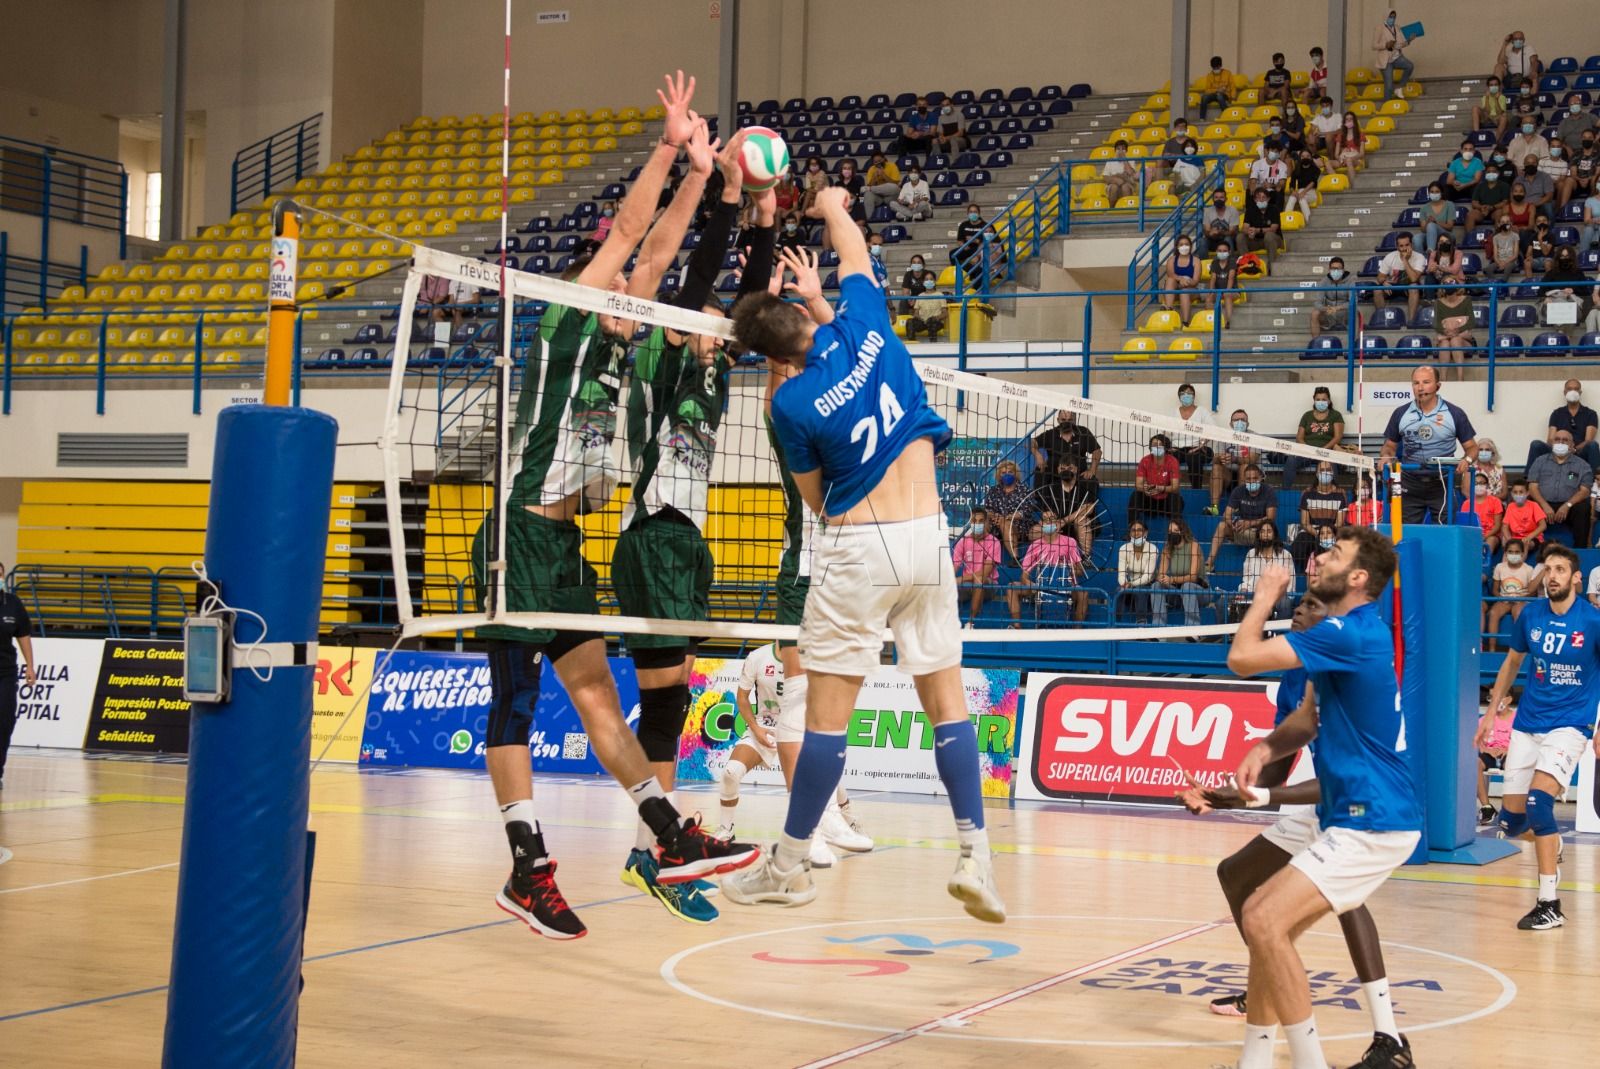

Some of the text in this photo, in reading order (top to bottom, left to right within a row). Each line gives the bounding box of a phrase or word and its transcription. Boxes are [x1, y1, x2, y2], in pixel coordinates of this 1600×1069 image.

[606, 296, 655, 319] rfevb.com
[923, 367, 954, 383] rfevb.com
[1001, 383, 1028, 398] rfevb.com
[1373, 391, 1411, 399] SECTOR
[850, 381, 907, 465] 24
[1542, 632, 1567, 655] 87
[113, 647, 145, 659] Becas
[1550, 663, 1582, 672] MELILLA
[107, 674, 160, 687] Impresión
[1550, 670, 1576, 679] SPORT
[1550, 677, 1582, 686] CAPITAL
[103, 697, 155, 710] Impresión
[383, 685, 493, 712] AL VOLEIBO
[101, 708, 147, 721] Formato
[1054, 697, 1233, 760] SVM
[98, 730, 155, 743] Señalética
[1048, 762, 1121, 782] SUPERLIGA
[1124, 765, 1189, 787] VOLEIBOL
